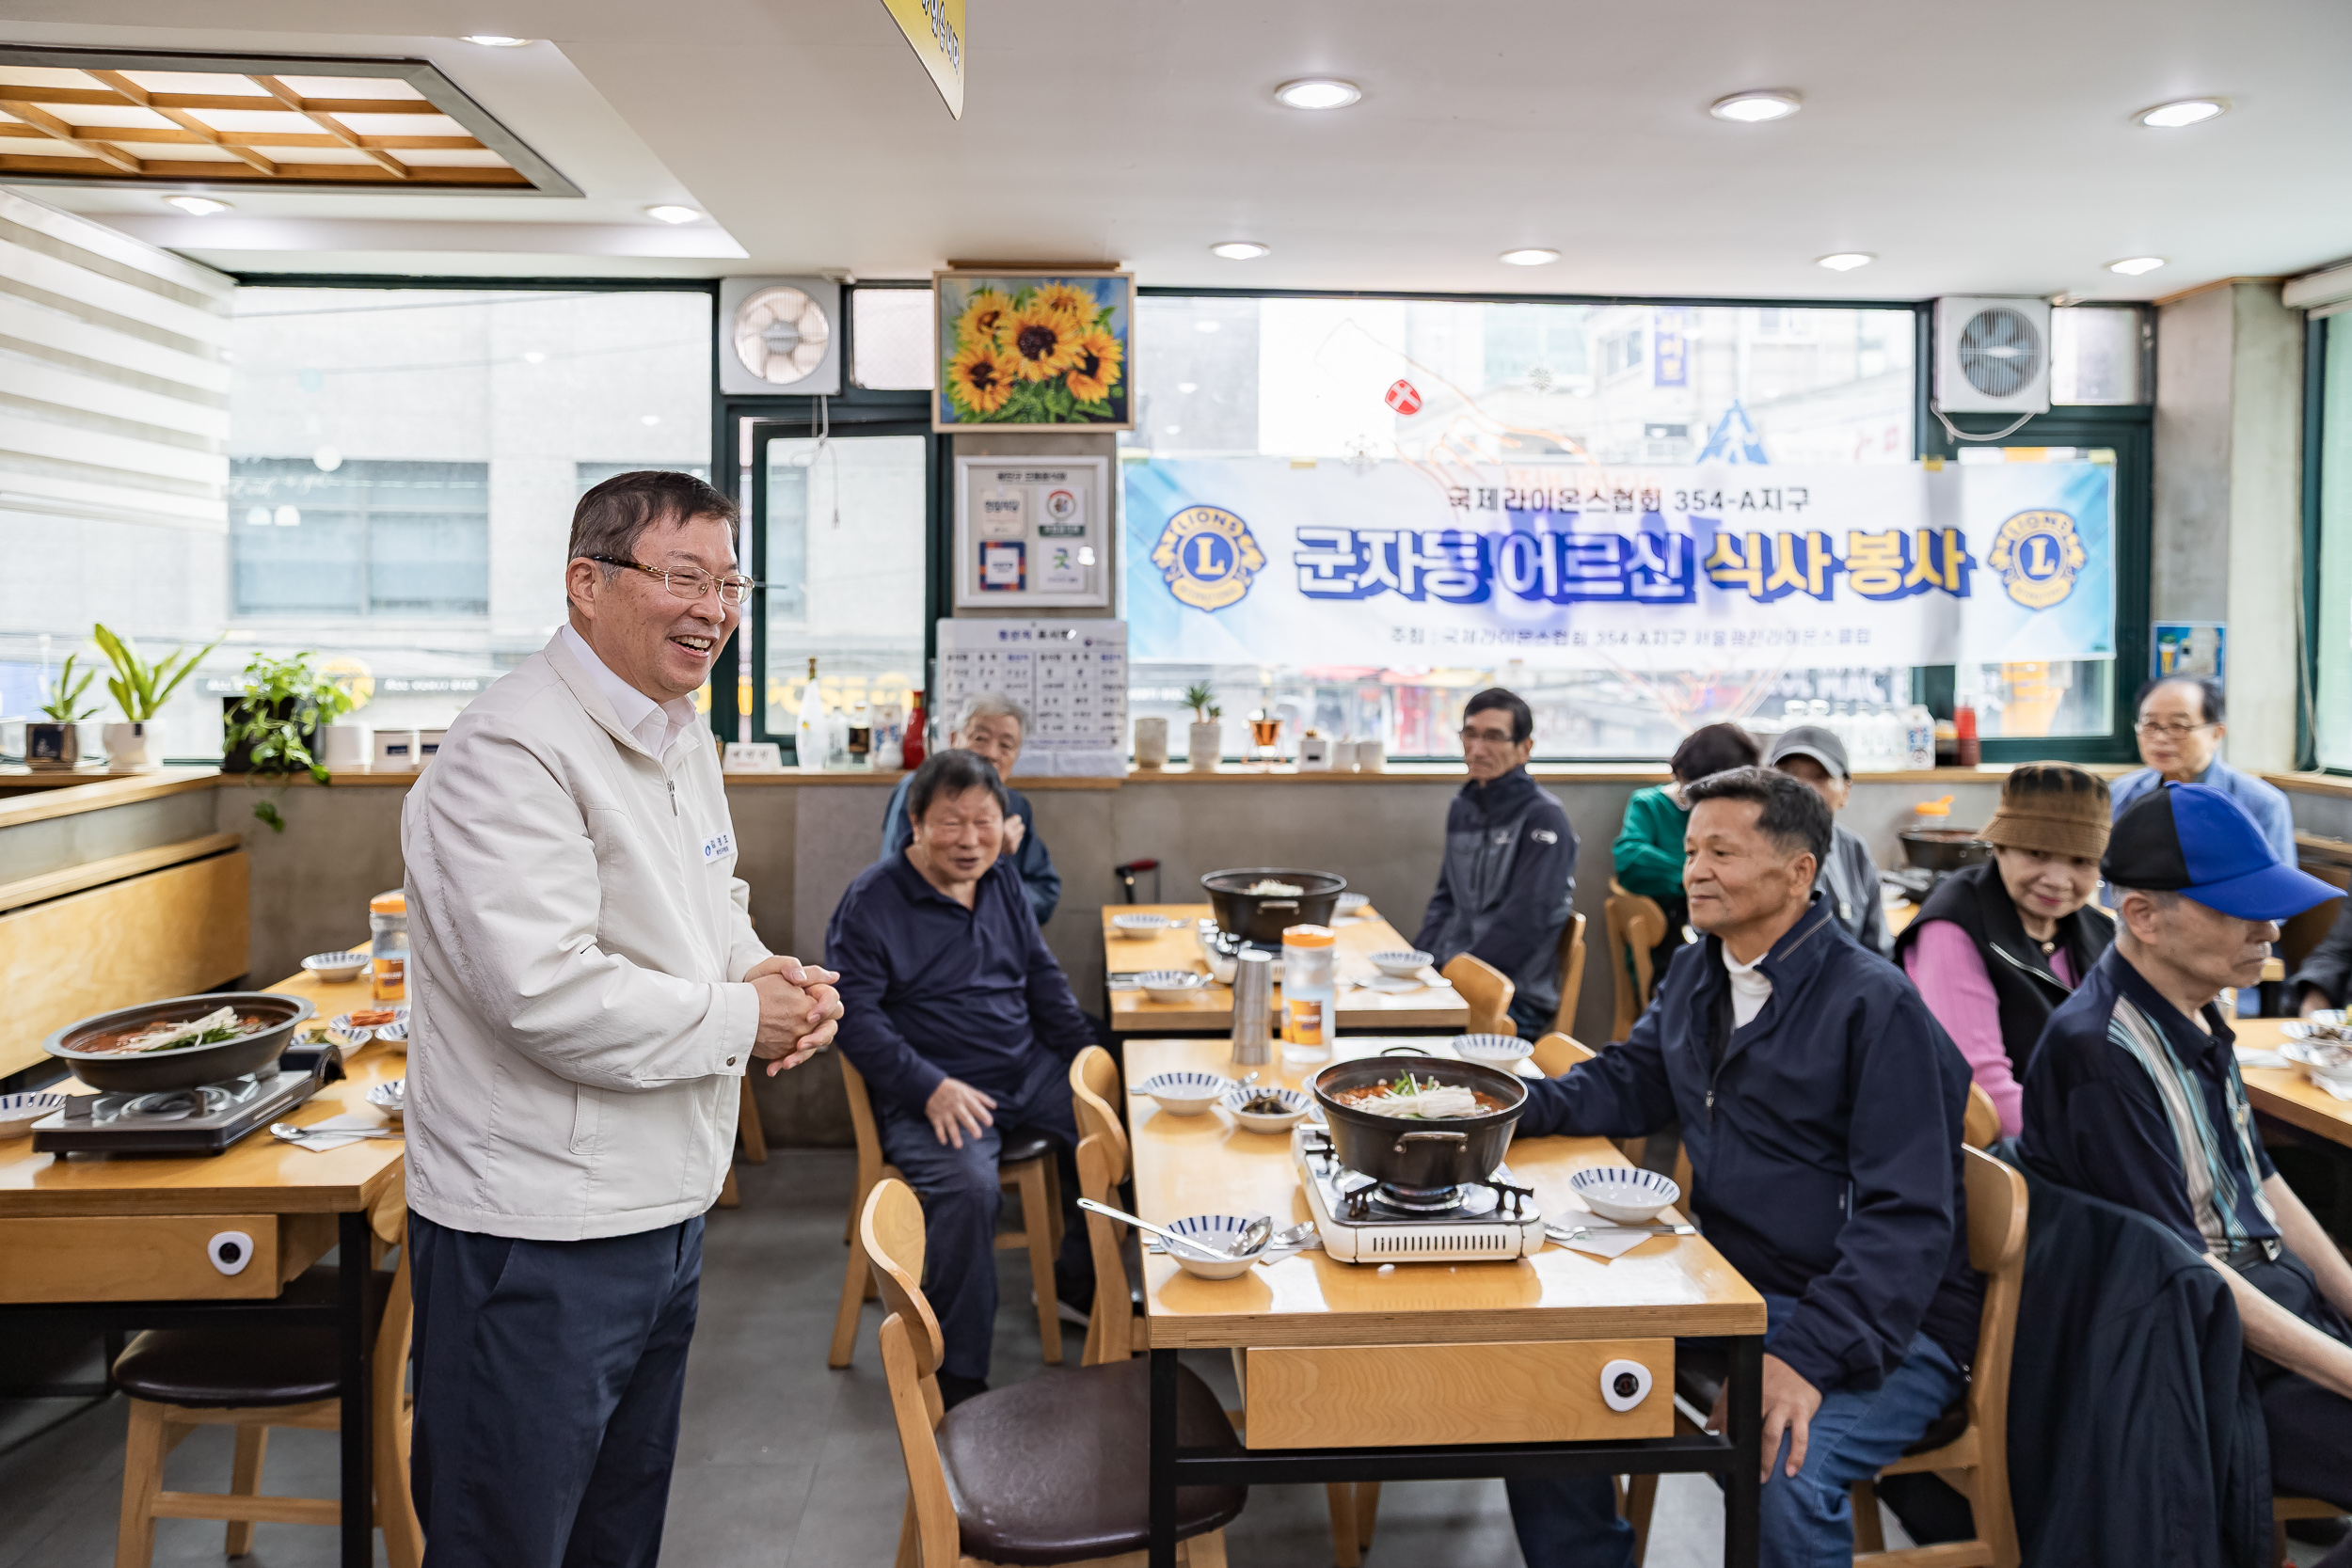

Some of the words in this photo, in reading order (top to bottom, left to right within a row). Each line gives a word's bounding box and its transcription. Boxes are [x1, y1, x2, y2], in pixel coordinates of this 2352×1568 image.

[1449, 485, 1662, 514] 국제라이온스협회
[1674, 487, 1810, 514] 354-A지구
[1177, 511, 1238, 533] LIONS
[1194, 536, 1227, 577] L
[1295, 526, 1490, 604] 군자동
[1498, 530, 1696, 604] 어르신
[1705, 530, 1837, 604] 식사
[1844, 526, 1977, 603] 봉사
[2028, 536, 2057, 577] L
